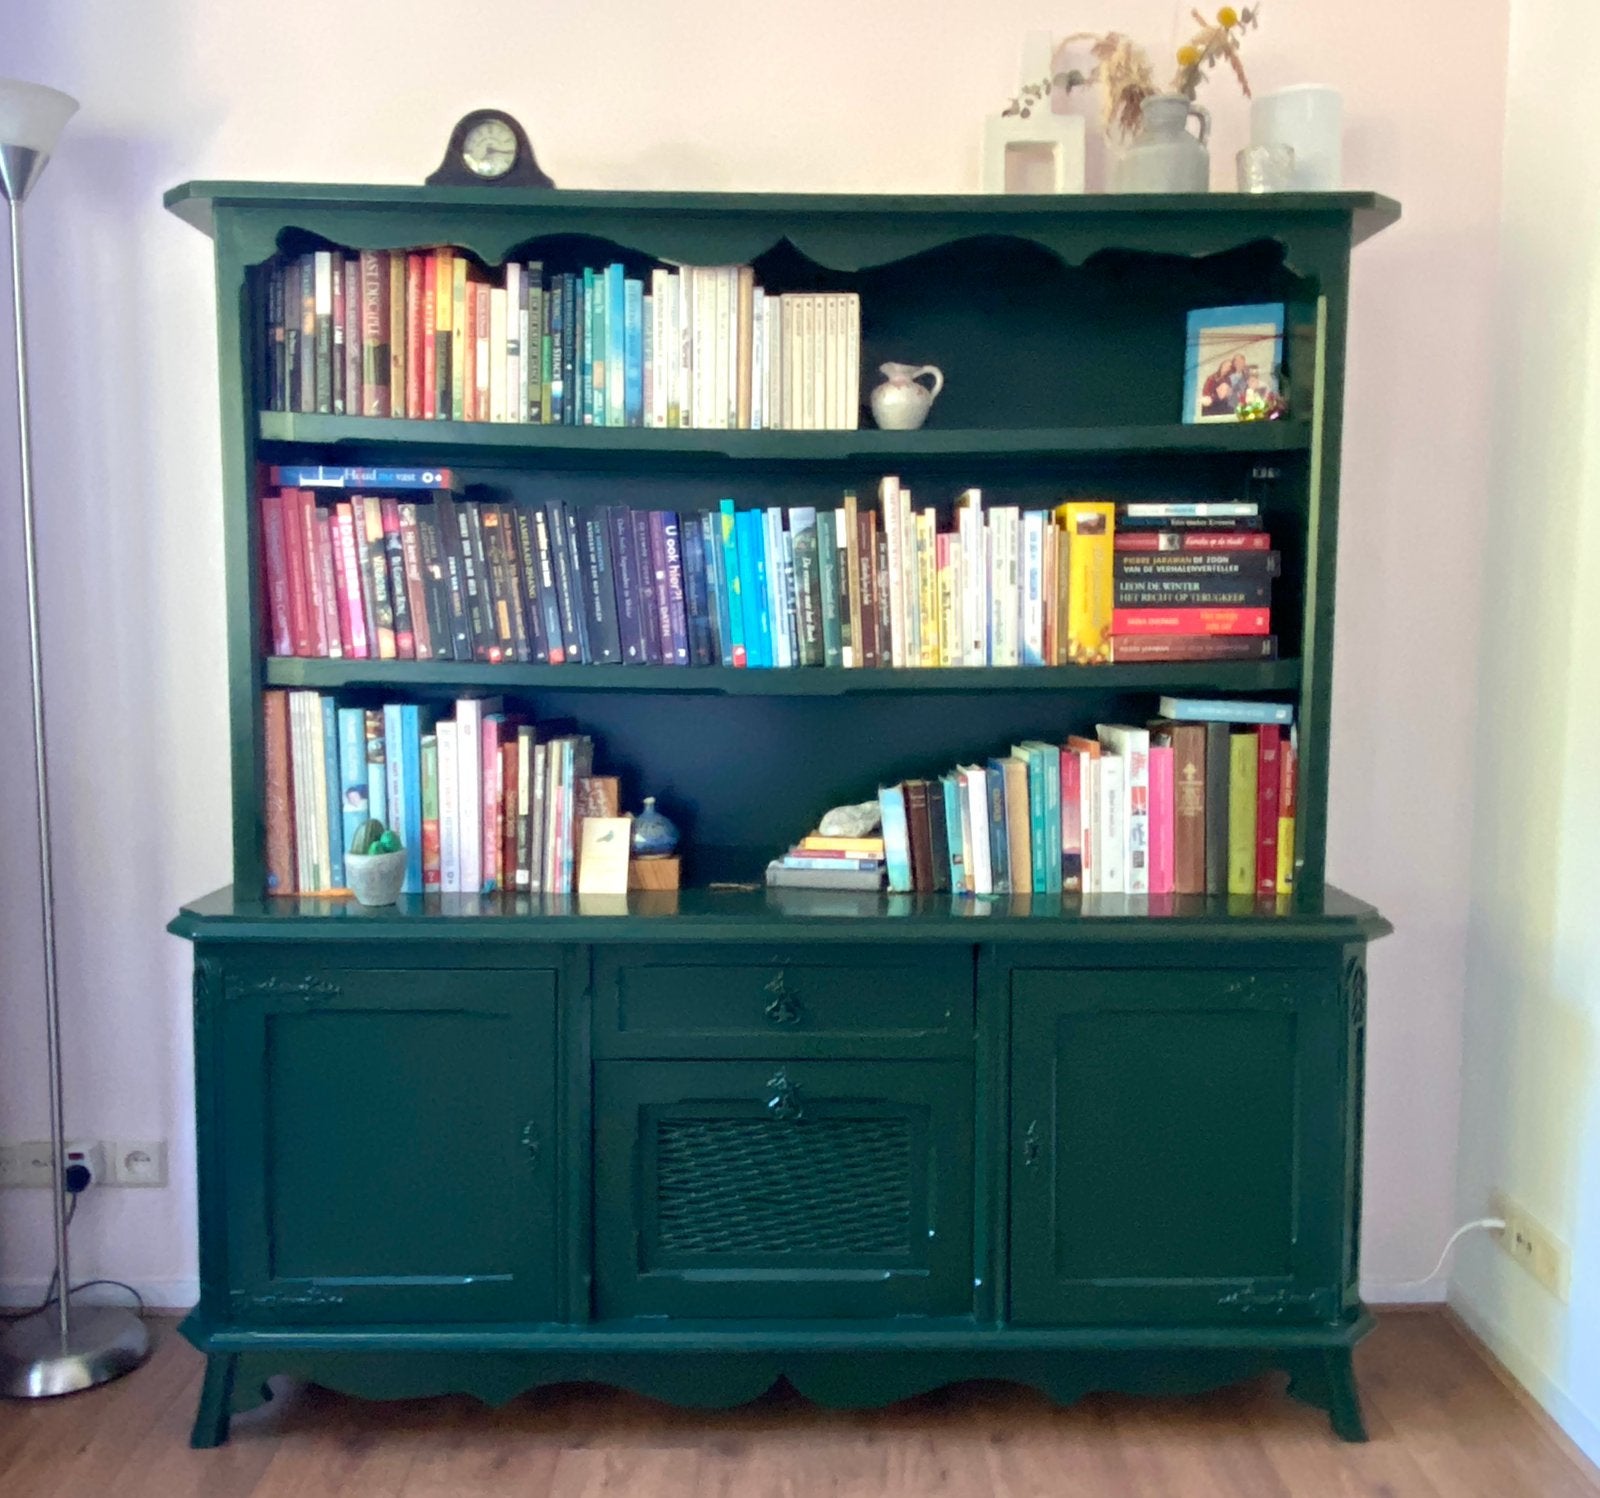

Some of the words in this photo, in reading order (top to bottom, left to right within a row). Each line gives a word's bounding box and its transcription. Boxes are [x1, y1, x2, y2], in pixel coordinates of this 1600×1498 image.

[366, 254, 378, 276] AST
[552, 348, 562, 380] SHACK
[665, 525, 677, 536] U
[665, 539, 678, 562] ook
[1156, 565, 1239, 573] VERHALENVERTELLER
[669, 565, 683, 600] hier?!
[1119, 582, 1145, 591] LEON
[1147, 582, 1160, 591] DE
[1163, 582, 1200, 591] WINTER
[1119, 593, 1138, 602] HET
[1175, 593, 1188, 602] OP
